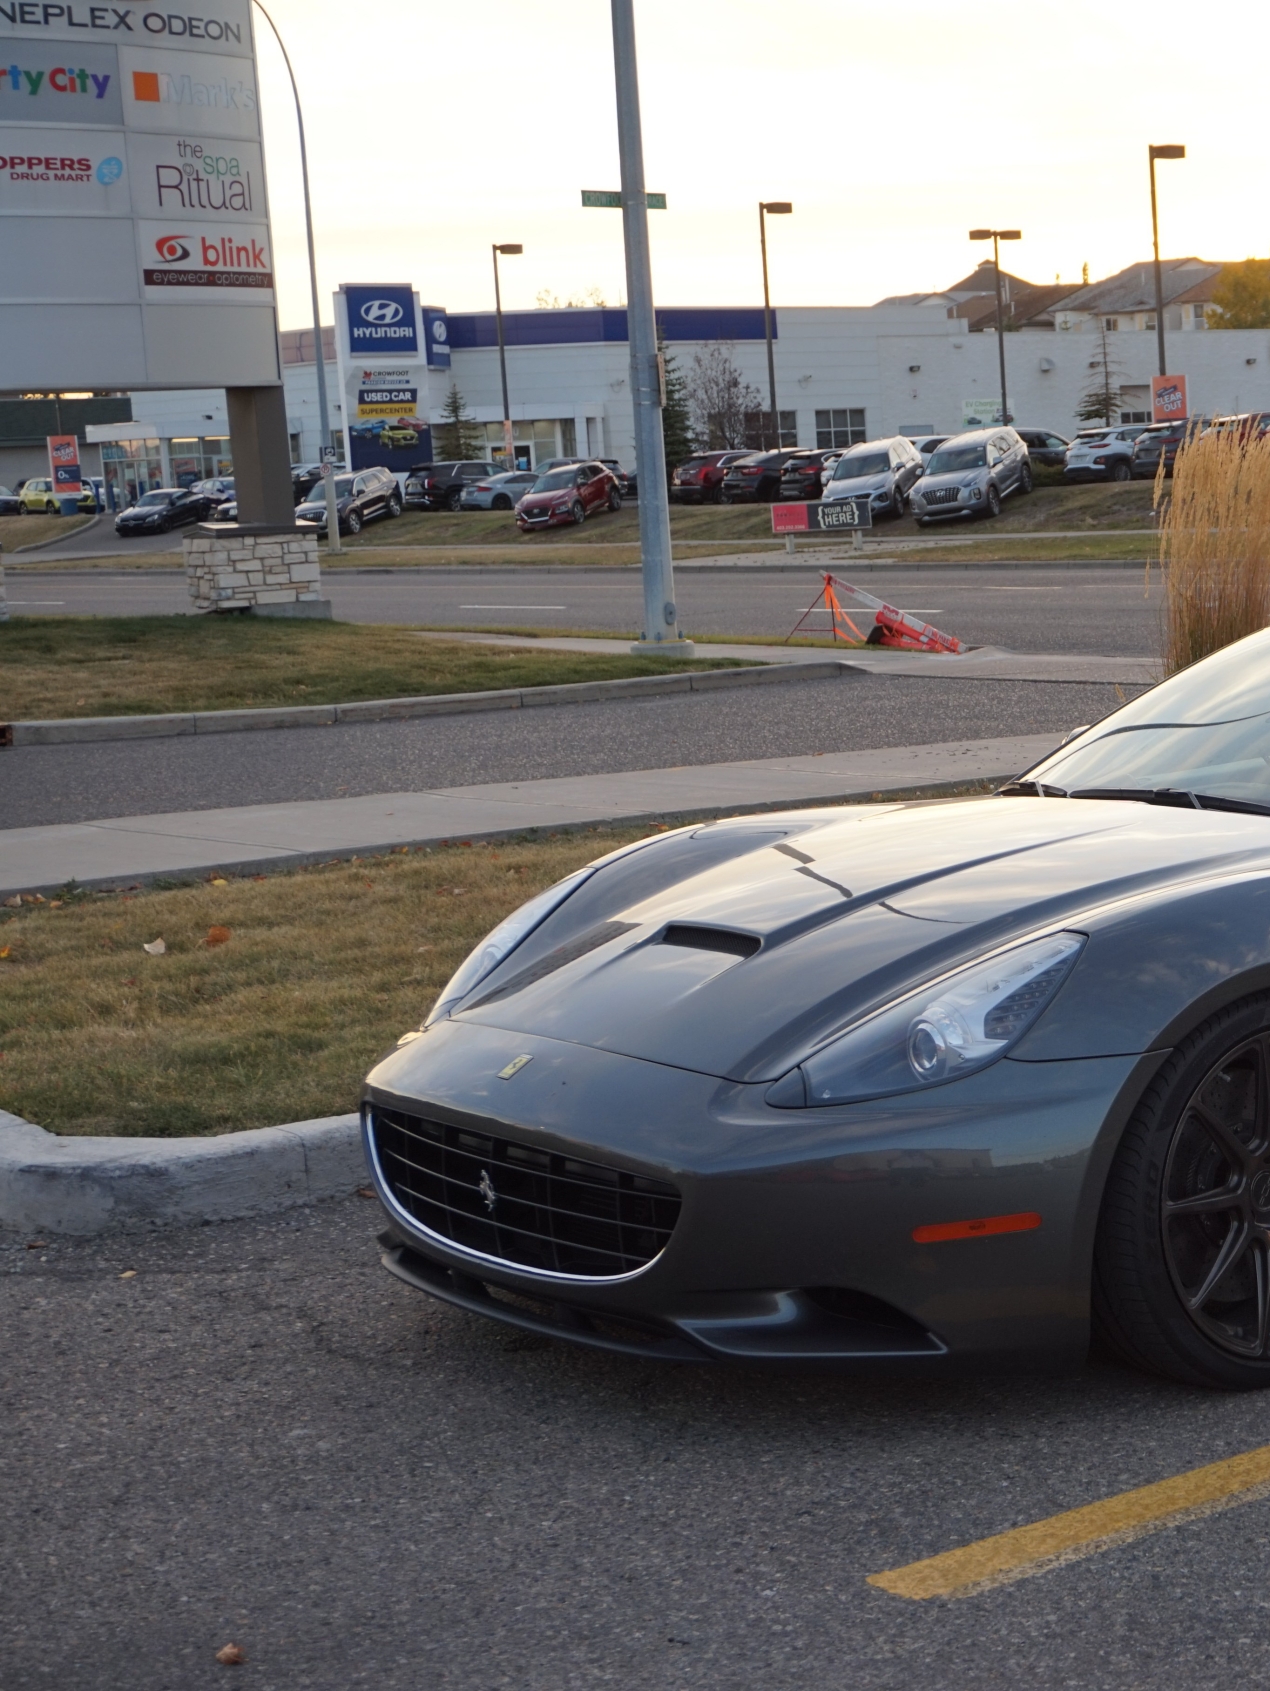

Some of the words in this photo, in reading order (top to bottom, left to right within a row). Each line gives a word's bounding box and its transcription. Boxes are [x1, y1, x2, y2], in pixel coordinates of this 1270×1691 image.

[143, 12, 241, 44] ODEON
[49, 67, 111, 99] City
[160, 73, 255, 111] Mark's
[177, 139, 203, 159] the
[203, 155, 241, 180] spa
[10, 172, 50, 181] DRUG
[53, 173, 92, 182] MART
[156, 165, 252, 211] Ritual
[201, 236, 267, 269] blink
[153, 272, 208, 284] eyewear
[214, 272, 269, 286] optometry
[354, 327, 413, 338] HYUNDAI
[364, 392, 390, 402] USED
[391, 391, 412, 401] CAR
[1155, 391, 1182, 406] CLEAR
[361, 406, 413, 415] SUPERCENTER
[1164, 400, 1182, 412] OUT
[824, 506, 841, 514] YOUR
[843, 504, 852, 512] AD
[824, 512, 854, 526] HERE
